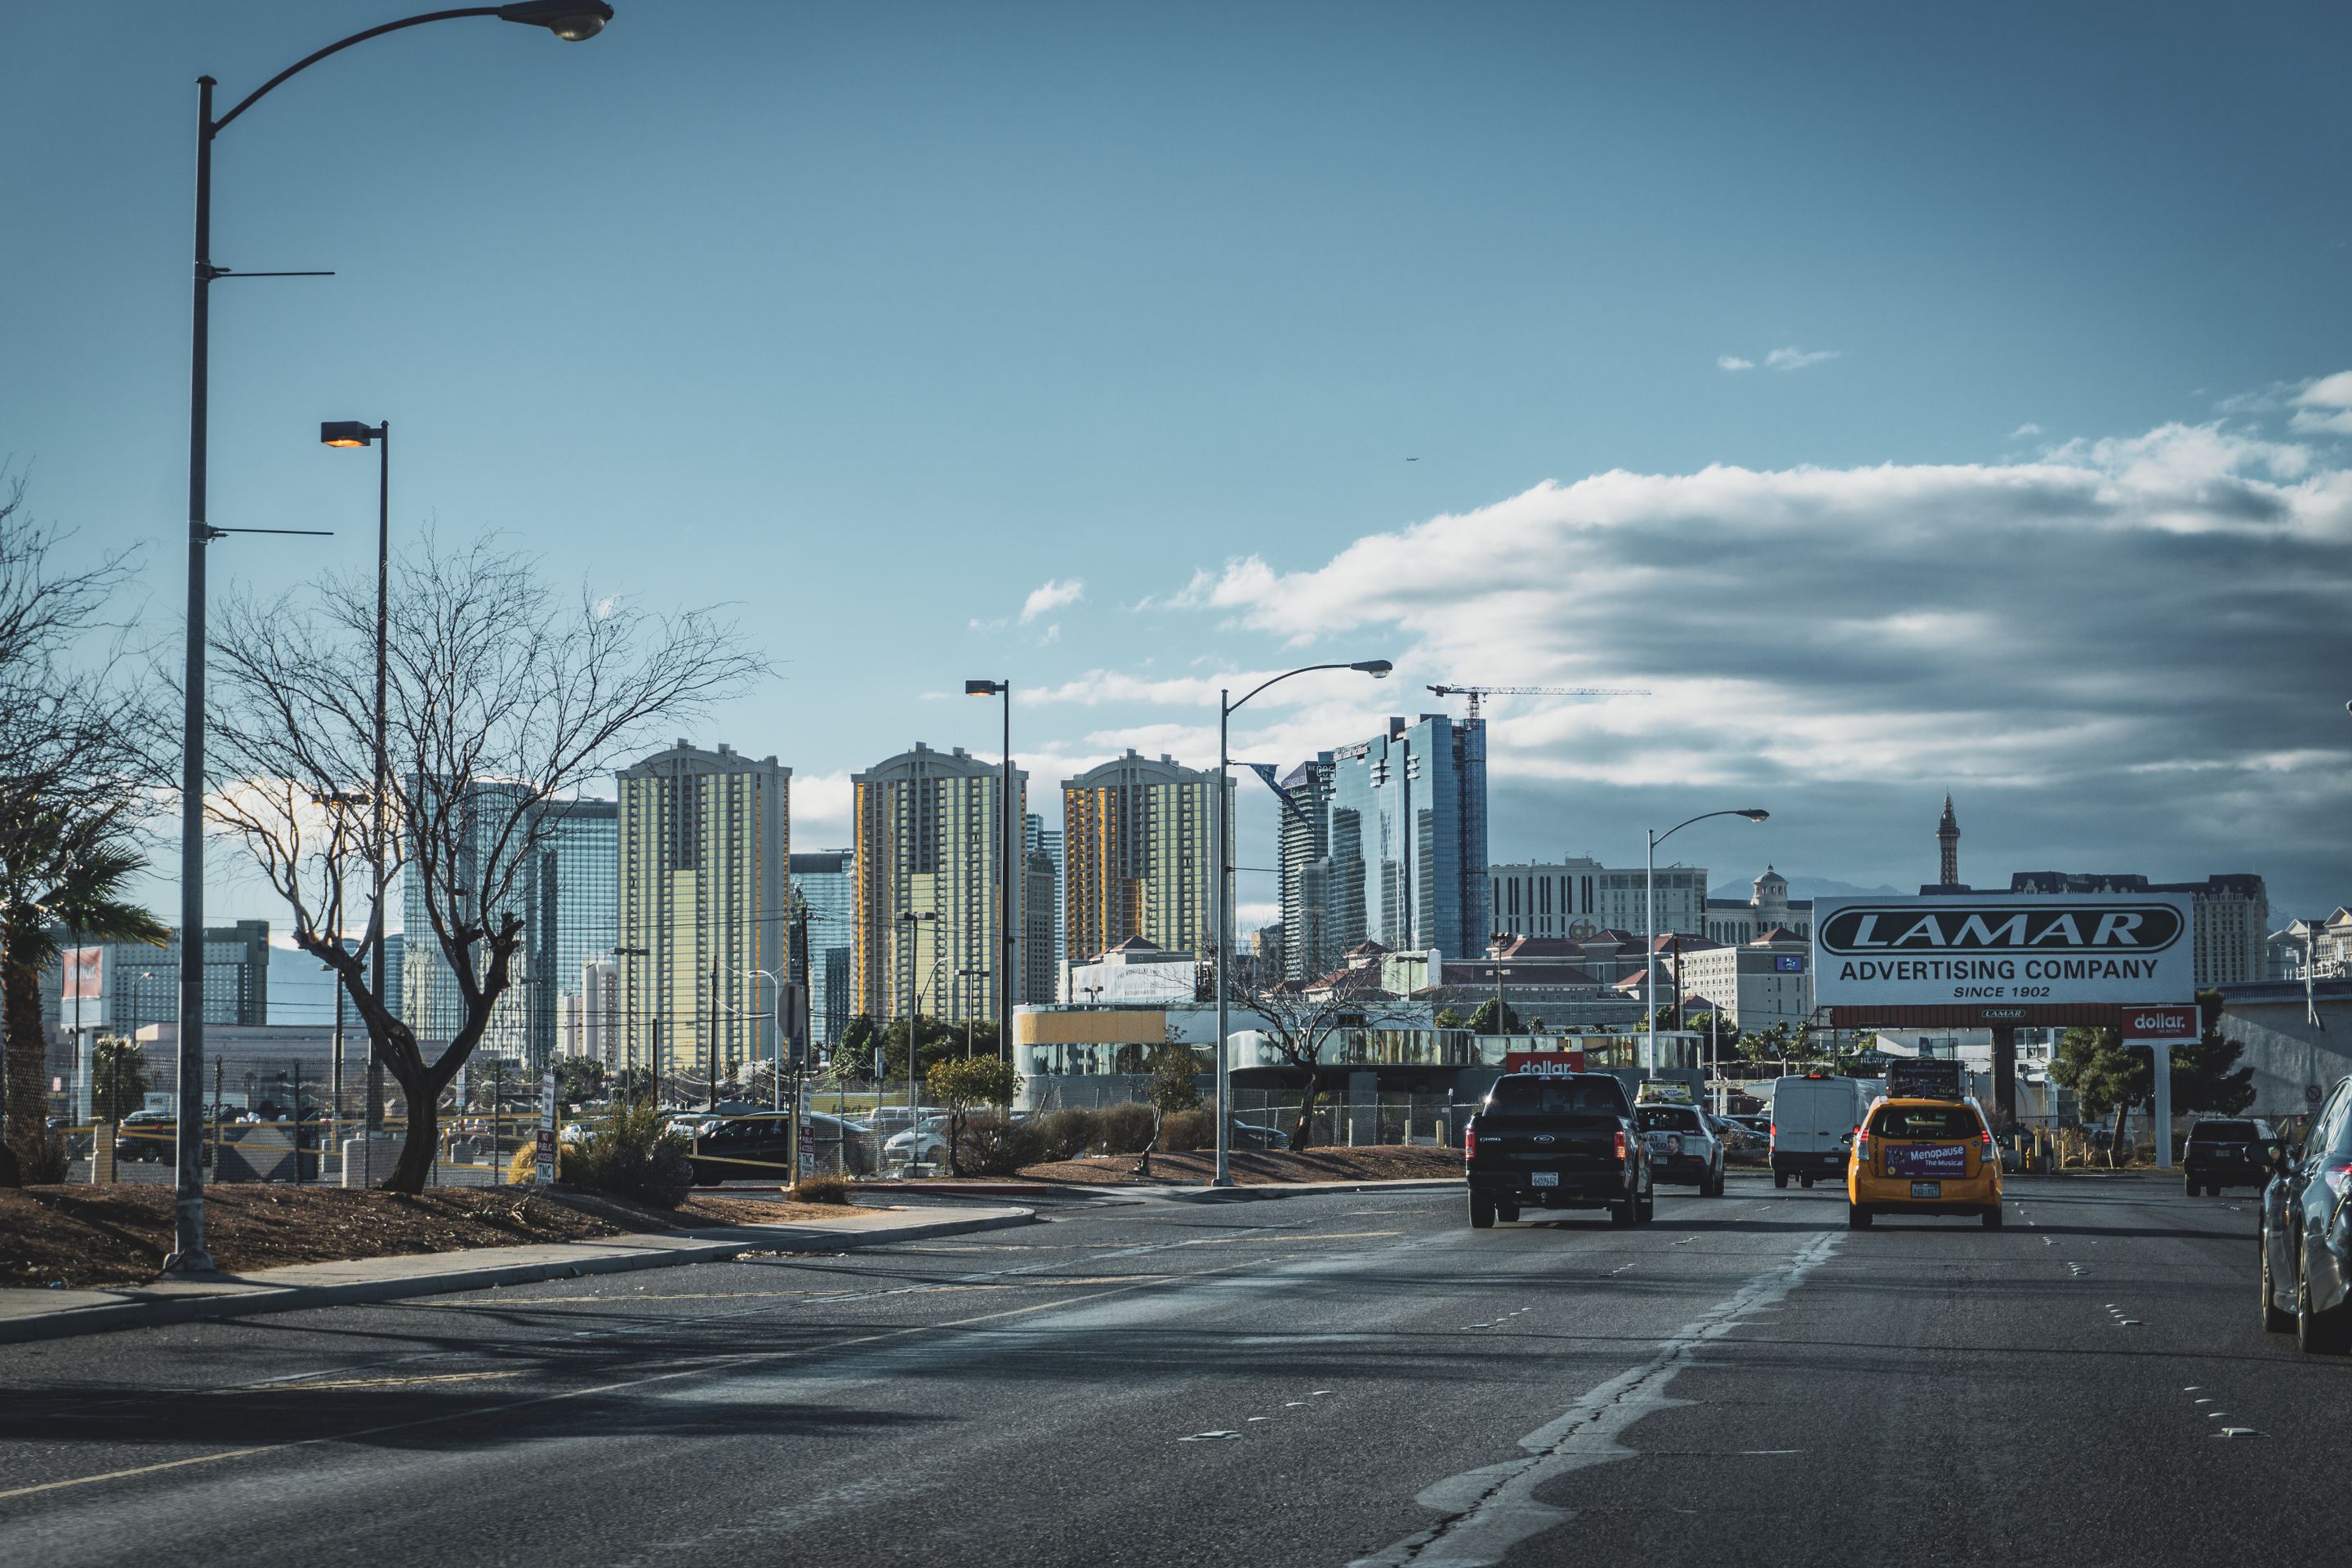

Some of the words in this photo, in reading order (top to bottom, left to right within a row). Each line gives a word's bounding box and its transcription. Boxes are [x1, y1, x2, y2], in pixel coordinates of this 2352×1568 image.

[1851, 913, 2144, 947] LAMAR
[1839, 960, 2015, 981] ADVERTISING
[2025, 959, 2158, 980] COMPANY
[1953, 987, 2005, 998] SINCE
[2011, 986, 2050, 998] 1902
[2134, 1013, 2185, 1029] dollar.
[541, 1133, 549, 1142] NO
[538, 1143, 553, 1152] PUBLIC
[1910, 1145, 1965, 1161] Menopause
[537, 1152, 554, 1162] ACCESS
[802, 1154, 813, 1165] TNC
[538, 1164, 552, 1178] TNC
